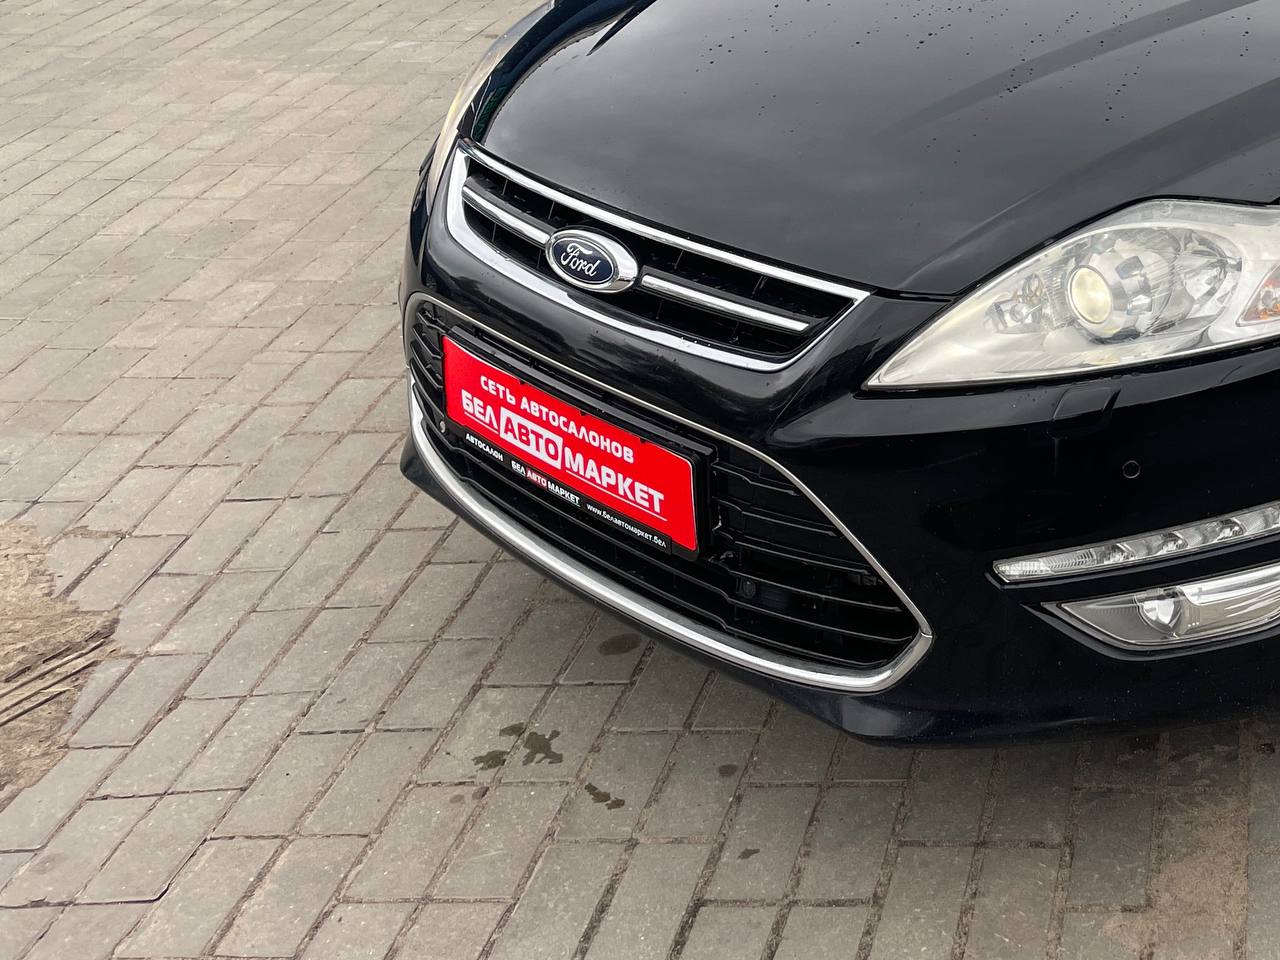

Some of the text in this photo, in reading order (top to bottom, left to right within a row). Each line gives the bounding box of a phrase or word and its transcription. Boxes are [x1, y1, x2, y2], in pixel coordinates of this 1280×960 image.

[561, 243, 600, 277] Ford
[466, 433, 503, 462] АВТОСАЛОН
[480, 375, 634, 464] СЕТЬ АВТОСАЛОНОВ
[461, 389, 665, 513] БЕЛ АВТО МАРКЕТ
